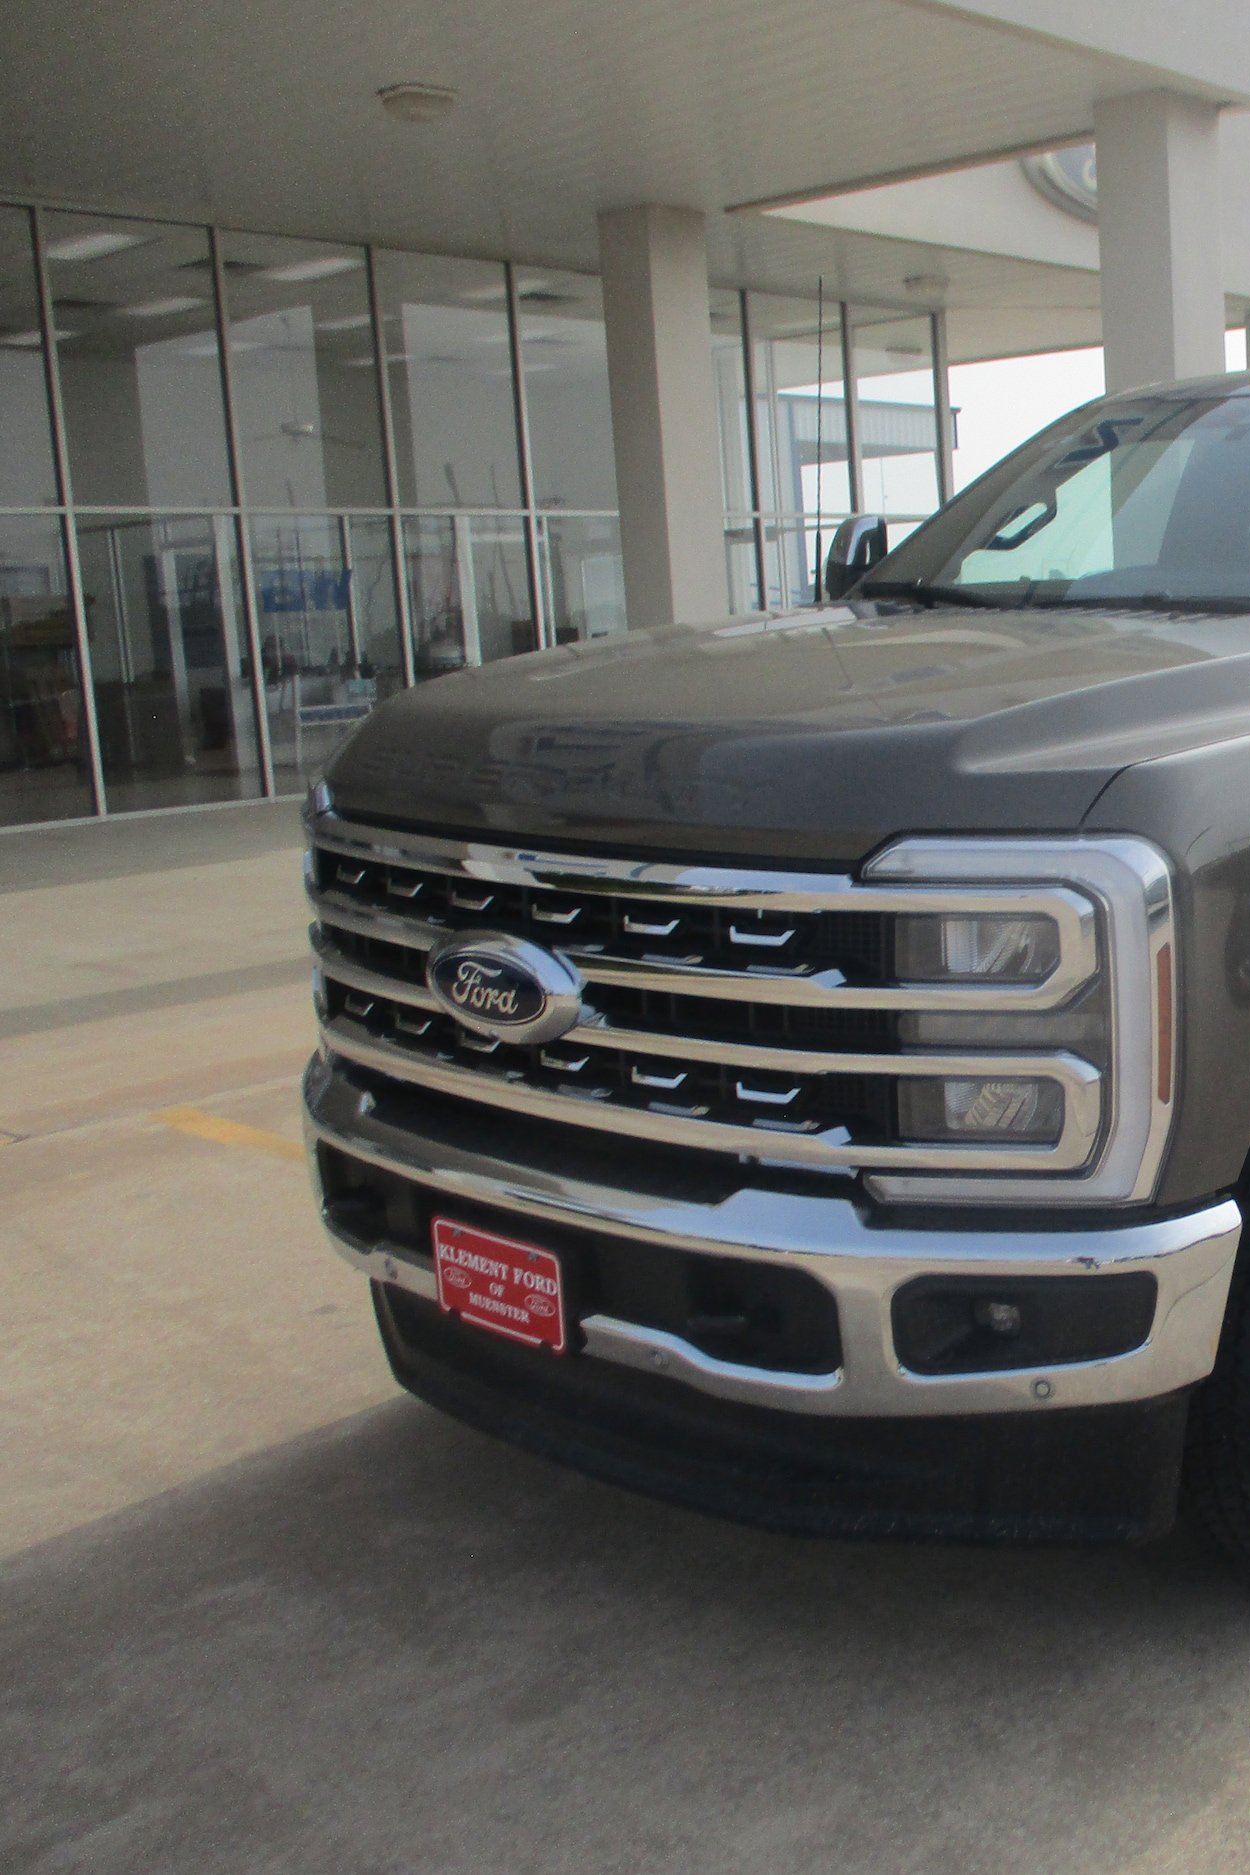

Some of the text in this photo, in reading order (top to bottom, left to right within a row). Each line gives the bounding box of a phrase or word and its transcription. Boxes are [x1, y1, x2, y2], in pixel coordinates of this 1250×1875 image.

[452, 960, 519, 1015] Ford
[438, 1243, 558, 1297] KLEMENT FORD
[489, 1282, 505, 1298] OF
[469, 1292, 530, 1324] MUENSTER
